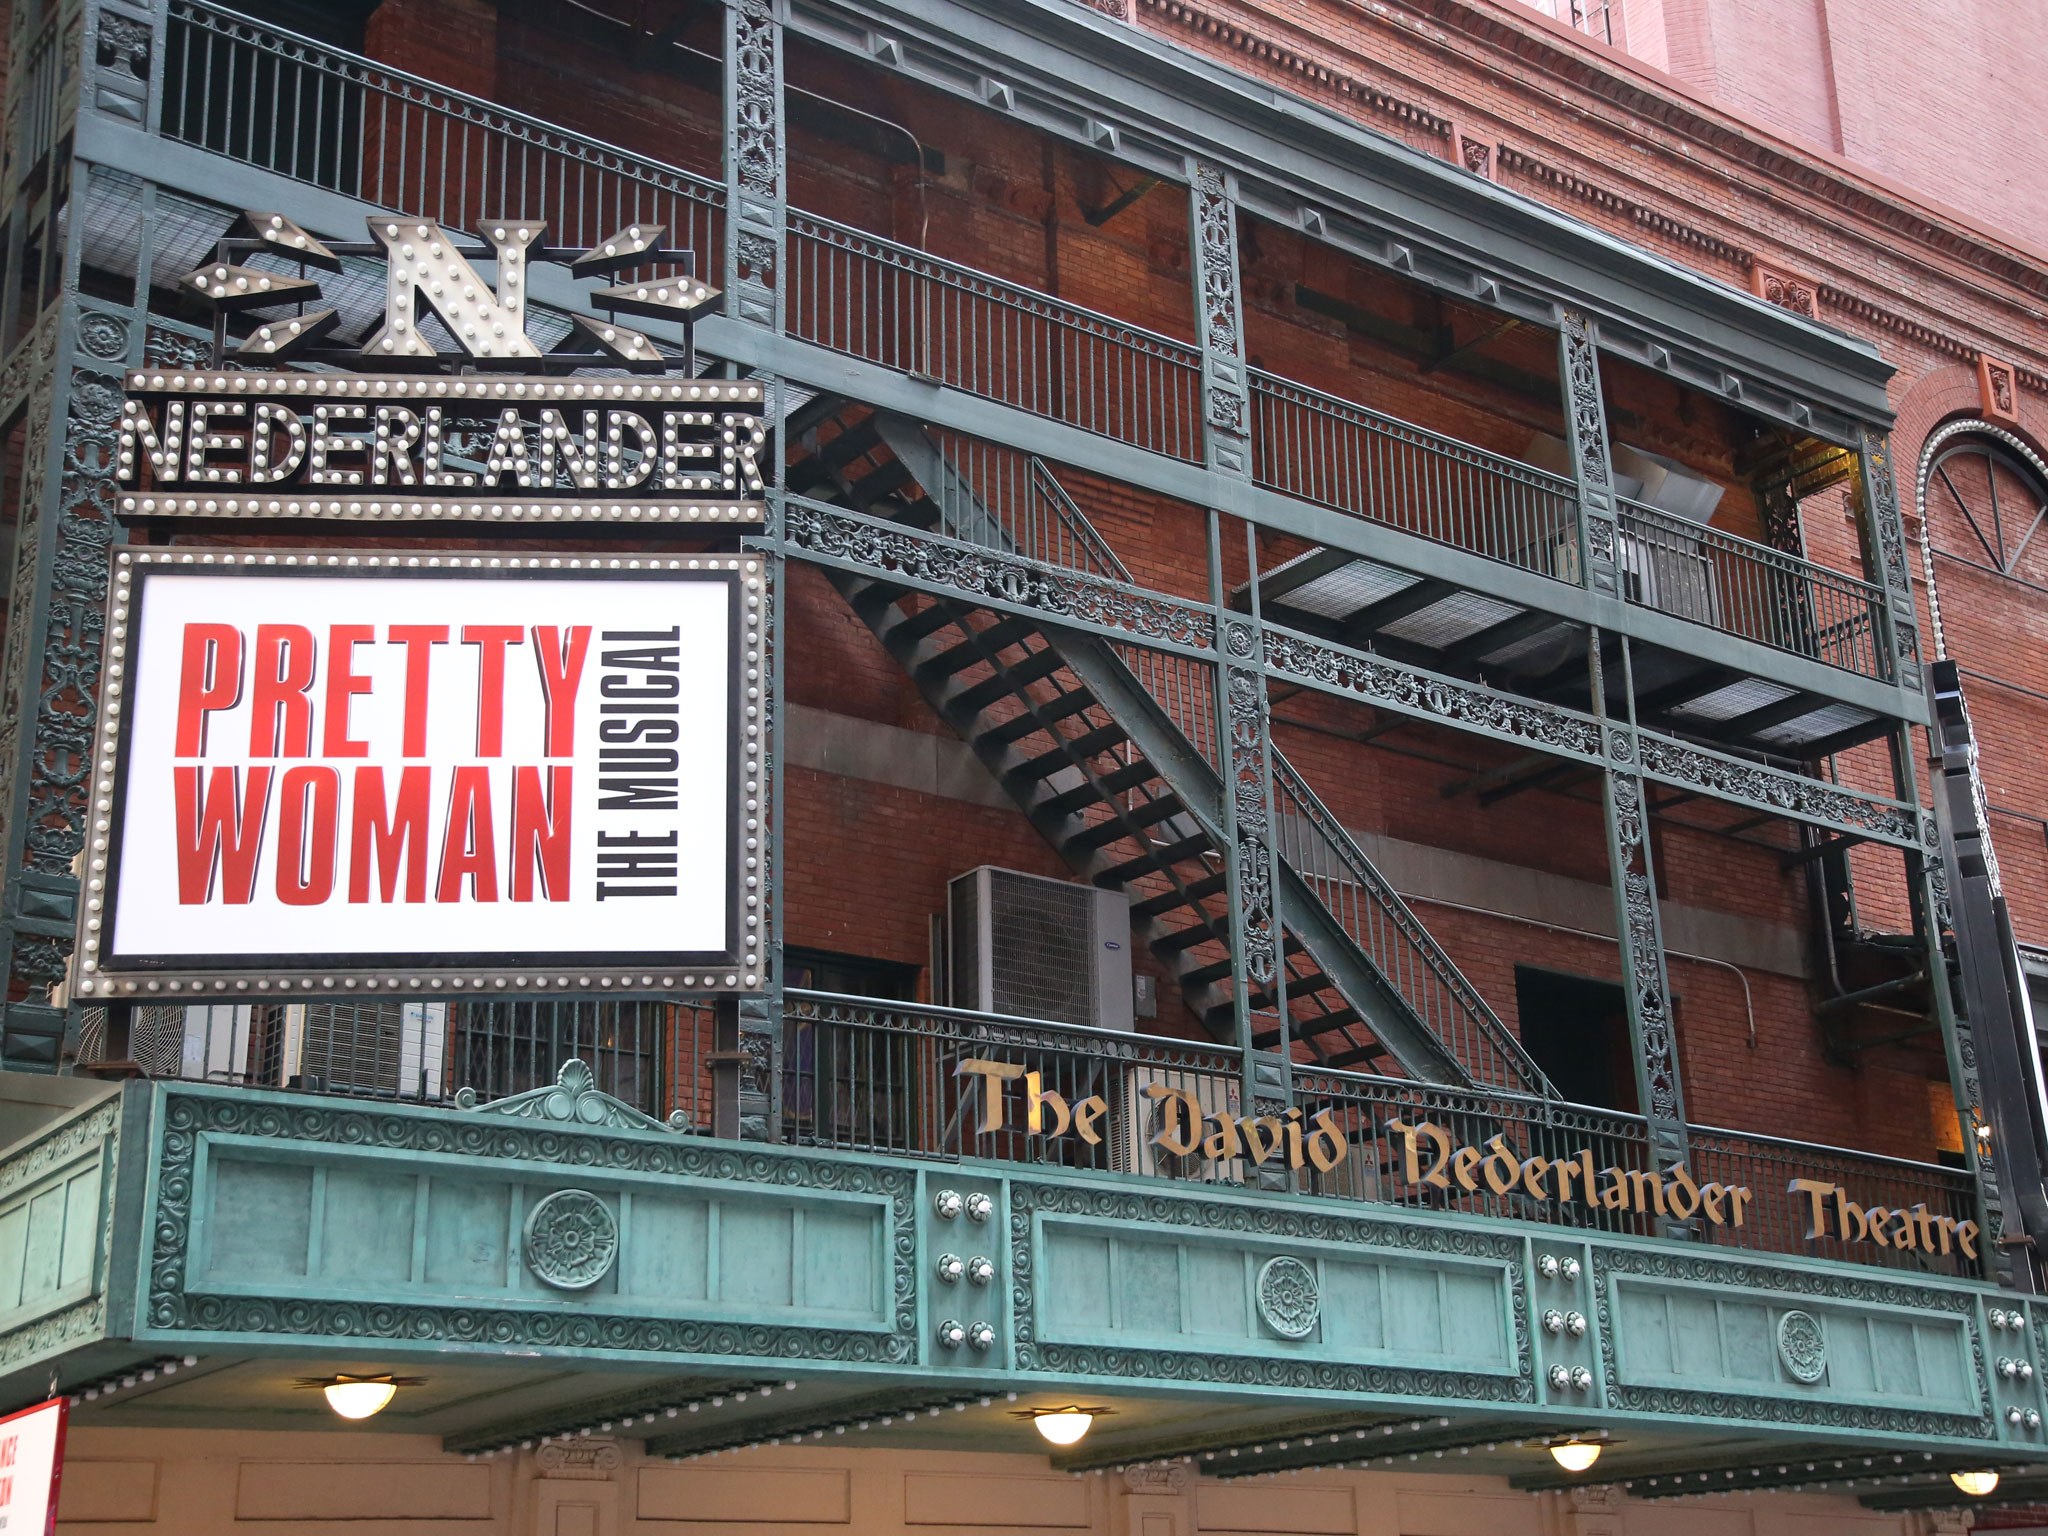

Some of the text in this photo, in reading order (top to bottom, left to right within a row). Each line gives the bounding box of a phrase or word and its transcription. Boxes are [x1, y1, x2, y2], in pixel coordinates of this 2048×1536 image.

[363, 217, 547, 374] N
[114, 399, 766, 492] NEDERLANDER
[174, 624, 594, 758] PRETTY
[596, 625, 682, 901] THE MUSICAL
[173, 765, 574, 905] WOMAN
[953, 1058, 1979, 1260] The David Nederlander Theatre
